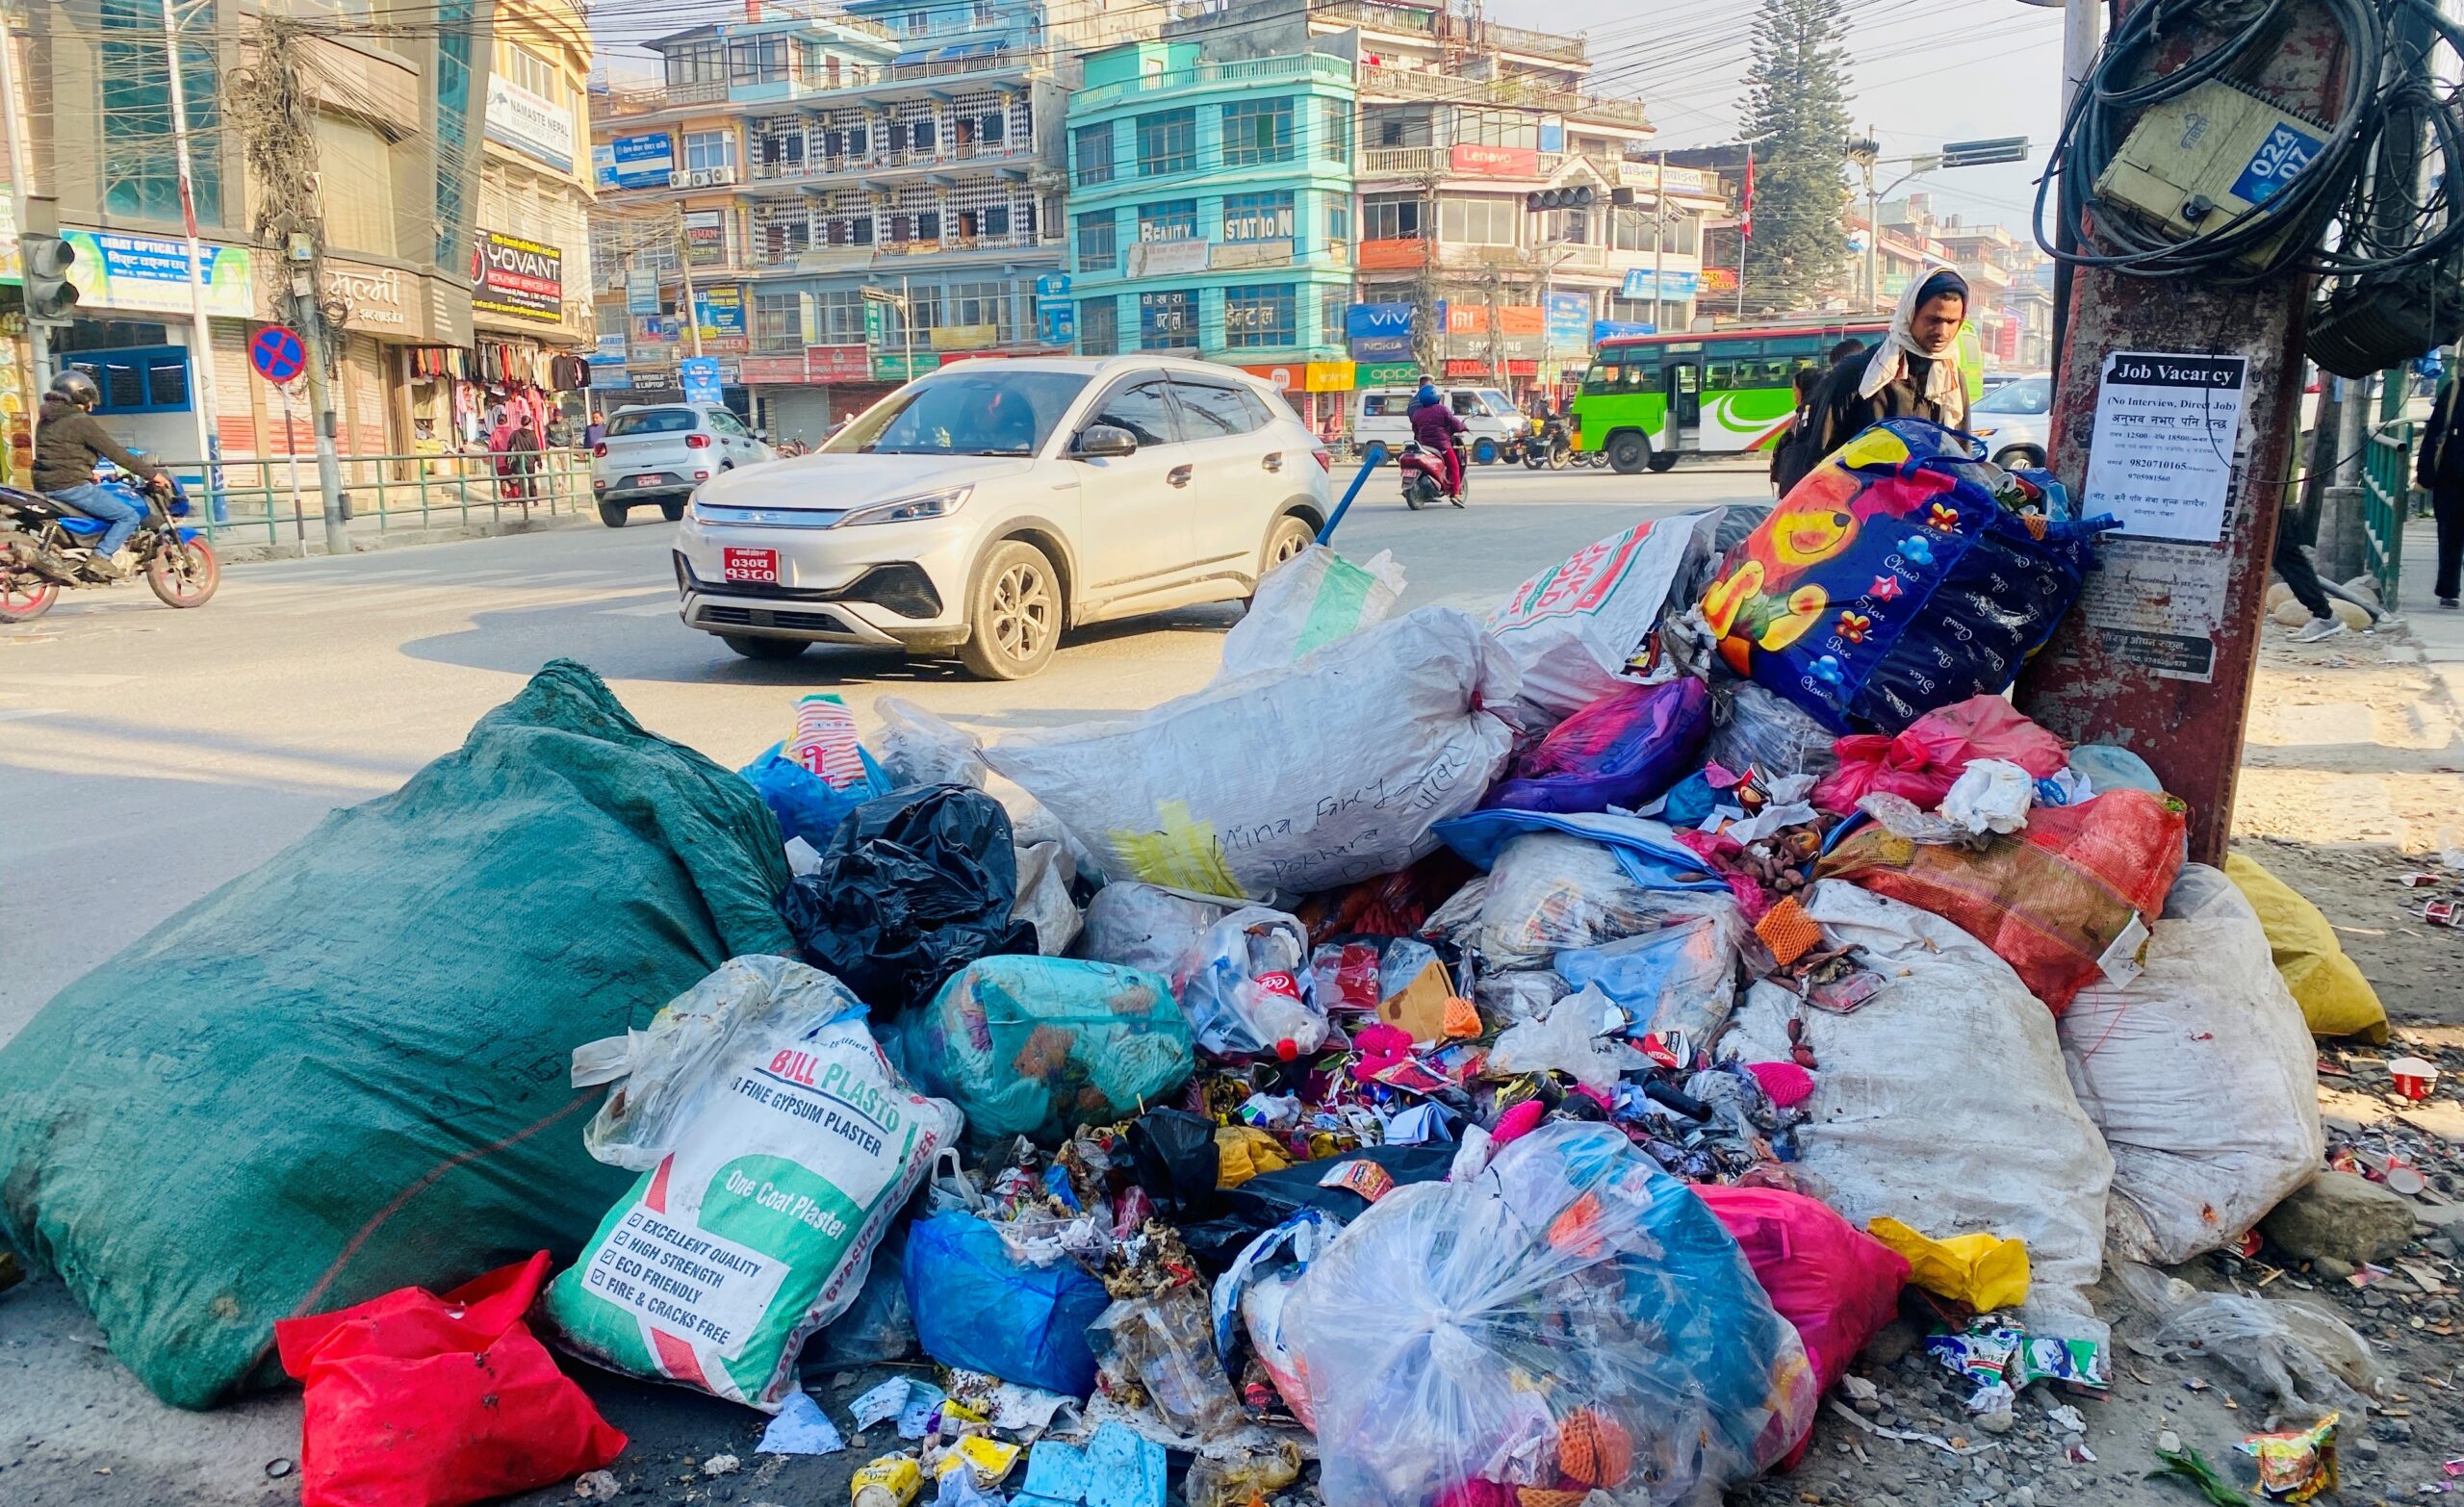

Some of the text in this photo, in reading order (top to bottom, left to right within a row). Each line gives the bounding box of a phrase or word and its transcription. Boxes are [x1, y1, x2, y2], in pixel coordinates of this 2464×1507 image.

[510, 99, 569, 138] NAMASTE NEPAL
[1463, 148, 1511, 164] Lenovo
[2250, 129, 2295, 177] 024
[1663, 169, 1700, 183] ोबाइल
[134, 239, 178, 256] OPTICAL
[487, 243, 559, 280] YOVANT
[1370, 309, 1410, 326] viv
[1363, 342, 1403, 351] NOKIA
[2119, 364, 2152, 379] Job
[2108, 396, 2125, 405] (No
[2128, 397, 2177, 408] Interview,
[2212, 401, 2237, 411] Job)
[2112, 413, 2145, 426] अनुभव
[2150, 416, 2175, 428] नभए
[2181, 415, 2200, 427] पनि
[2127, 473, 2171, 482] 9705981560
[2129, 458, 2187, 471] 9820710165
[1917, 524, 1942, 542] Bee
[1884, 554, 1920, 582] Cloud
[1990, 573, 2009, 594] Bee
[1855, 595, 1886, 622] Star
[1942, 616, 1973, 641] Cloud
[1826, 635, 1852, 659] Bee
[1933, 646, 1954, 669] Bee
[1984, 646, 2005, 672] Cloud
[1910, 668, 1936, 695] Star
[1213, 779, 1391, 857] Mina Fancy
[1272, 829, 1378, 881] Pokhara
[769, 1048, 819, 1086] BULL
[820, 1062, 901, 1133] PLASTO
[740, 1079, 774, 1104] FINE
[772, 1092, 824, 1124] GYPSUM
[824, 1111, 883, 1158] PLASTER
[725, 1169, 847, 1241] One Coat Plaster
[825, 1218, 880, 1302] GYPSUM
[883, 1129, 938, 1214] PLASTER
[641, 1218, 762, 1279] EXCELLENT QUALITY
[628, 1238, 725, 1289] HIGH STRENGTH
[615, 1256, 704, 1305] ECO FRIENDLY
[605, 1277, 732, 1345] FIRE & CRACKS FREE
[1978, 1353, 2004, 1365] NOVA
